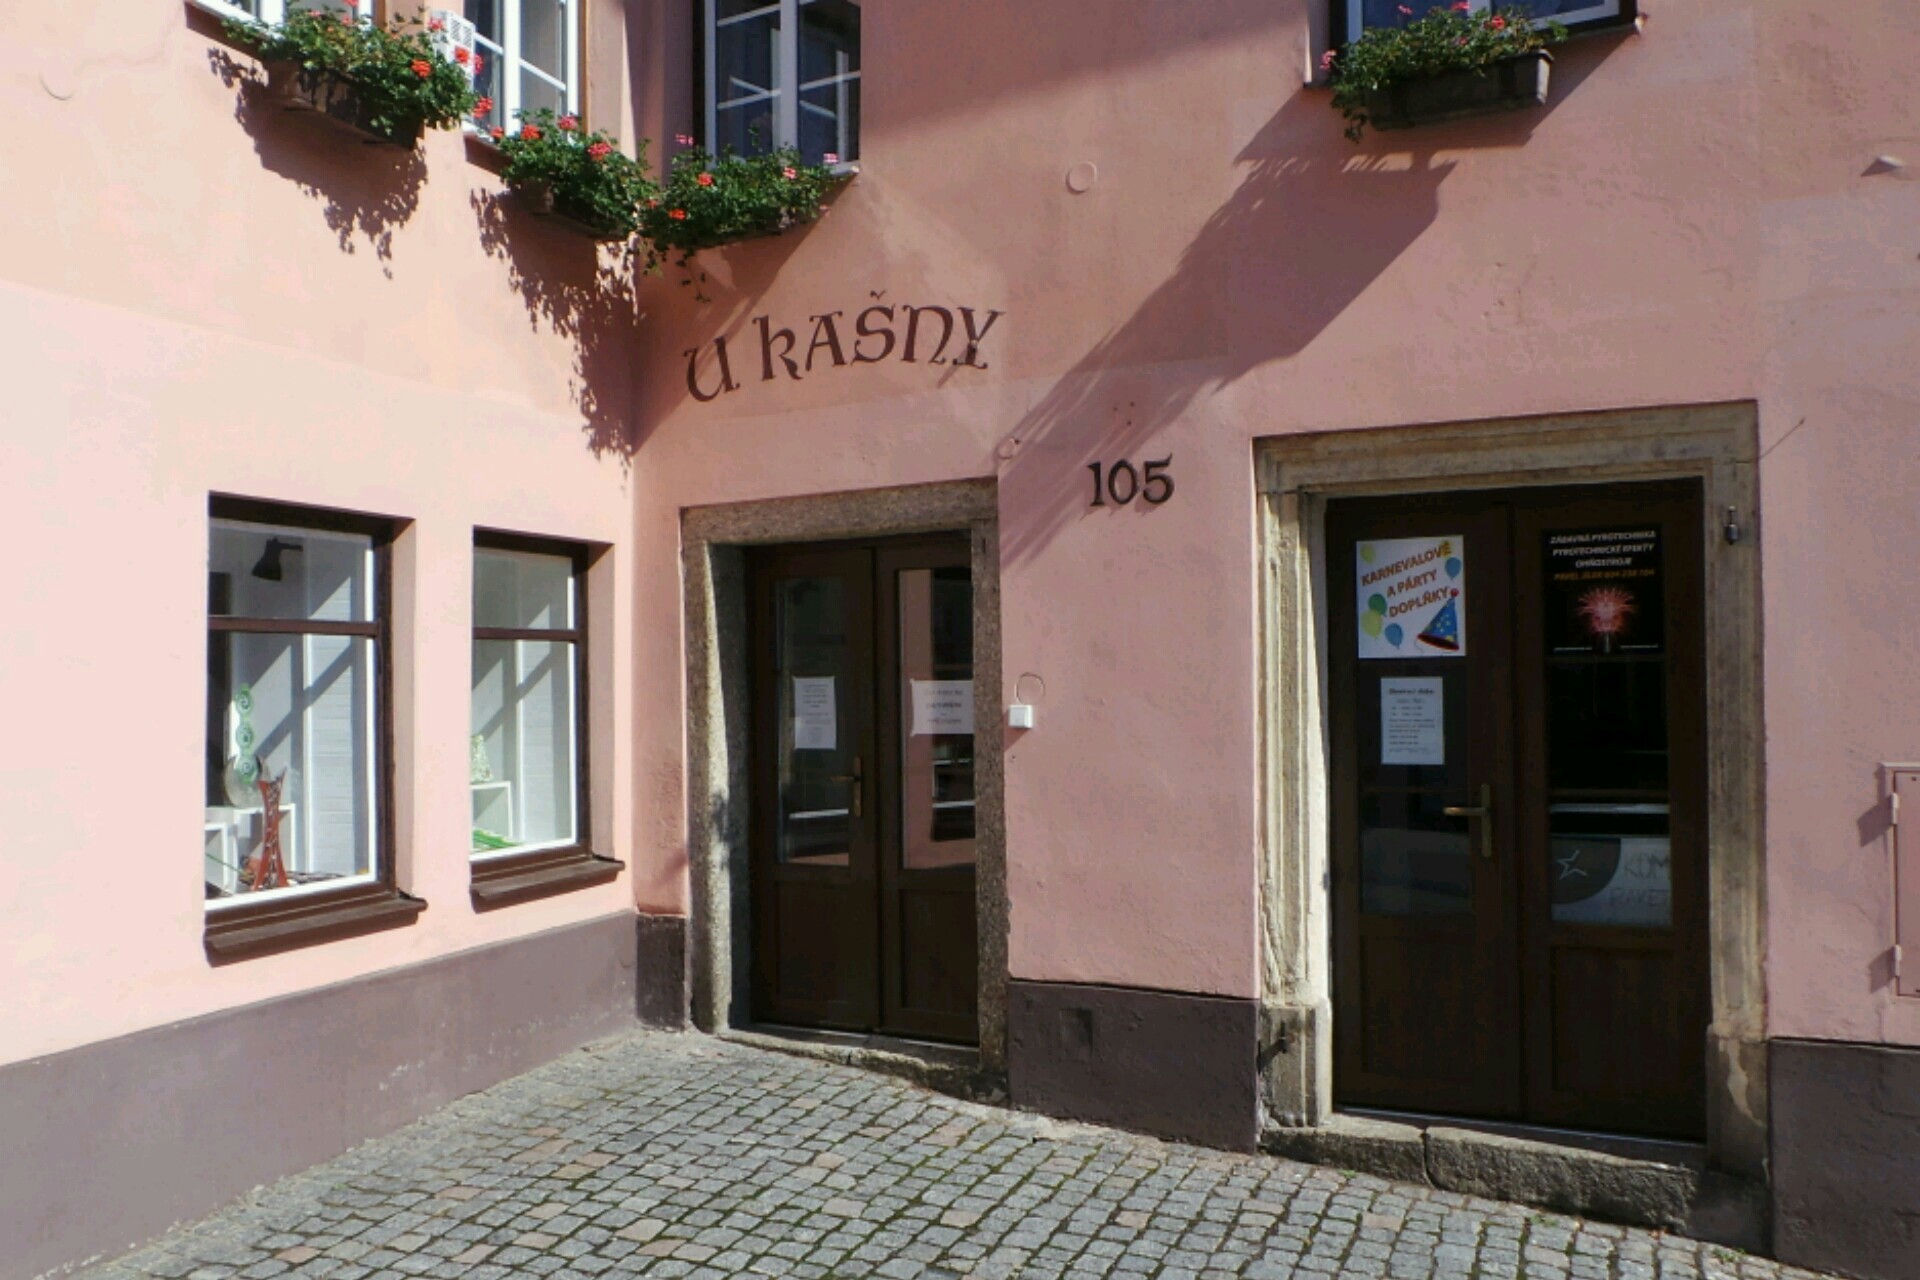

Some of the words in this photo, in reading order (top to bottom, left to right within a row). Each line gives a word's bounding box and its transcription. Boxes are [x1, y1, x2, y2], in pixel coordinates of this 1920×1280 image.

[683, 335, 741, 402] U
[1087, 453, 1175, 507] 105
[1361, 540, 1452, 587] KARNEVALOVÉ
[1387, 585, 1396, 598] A
[1397, 568, 1437, 594] PÁRTY
[1389, 585, 1449, 618] DOPLŇKY
